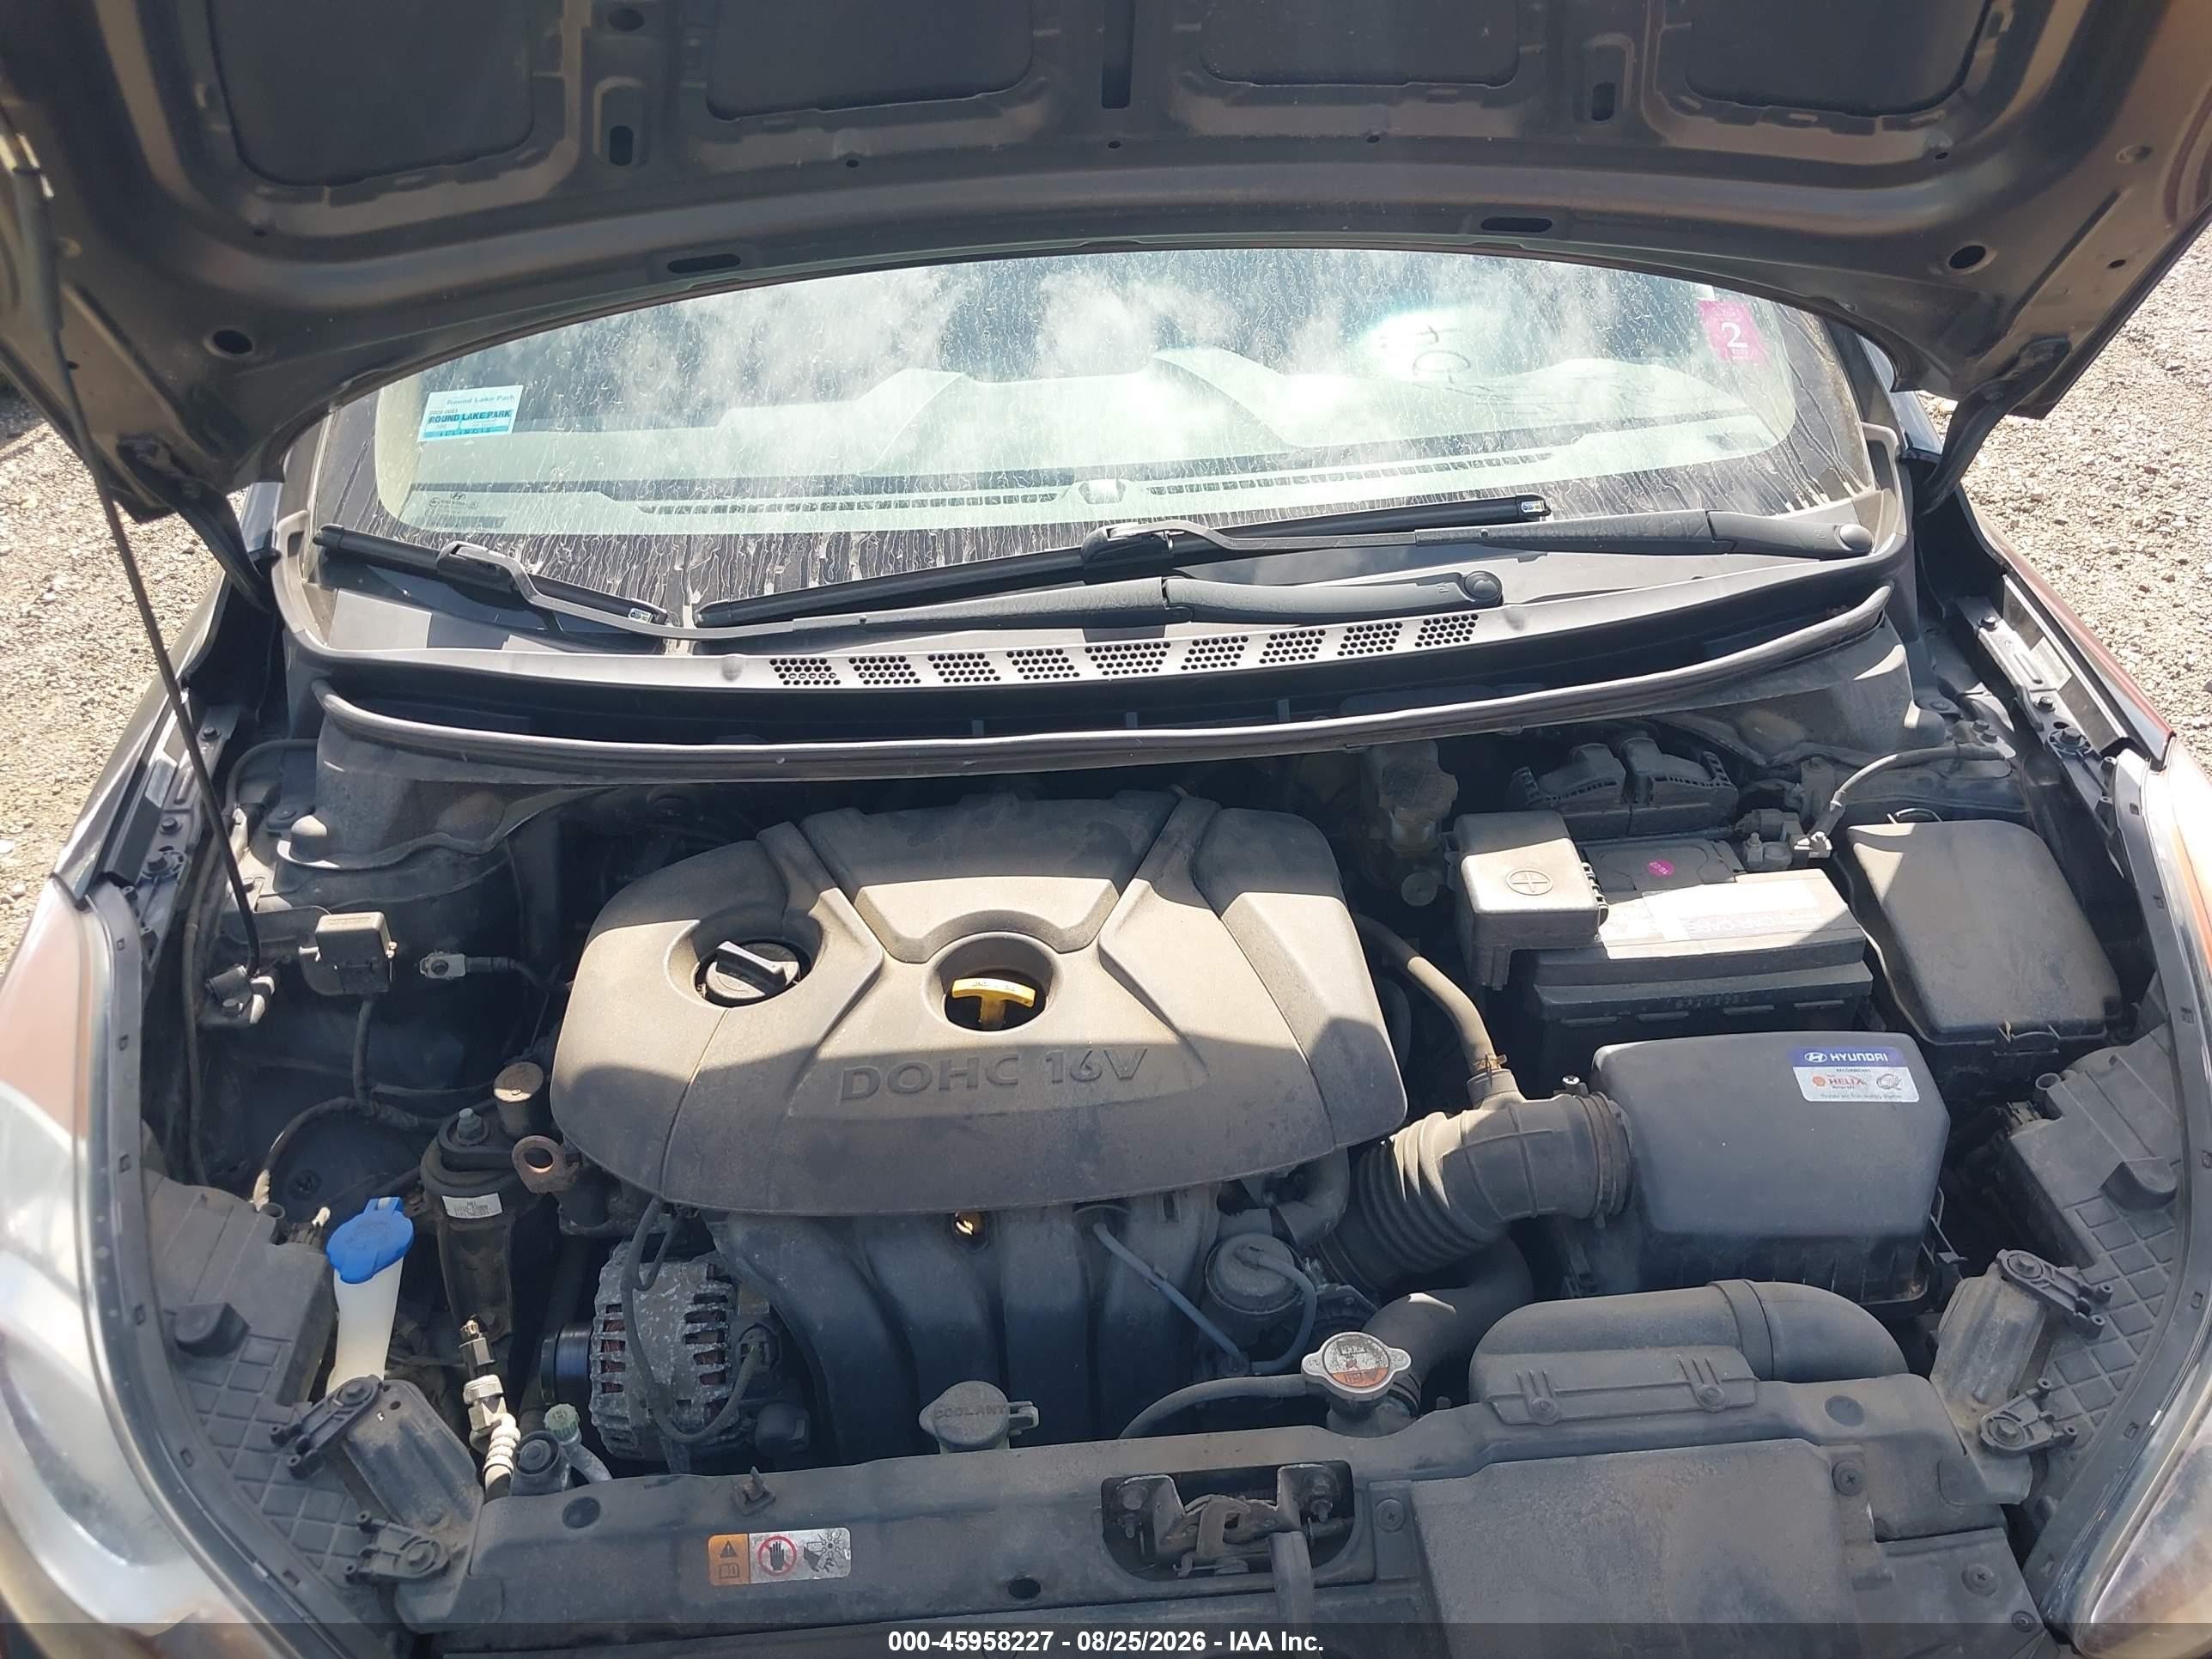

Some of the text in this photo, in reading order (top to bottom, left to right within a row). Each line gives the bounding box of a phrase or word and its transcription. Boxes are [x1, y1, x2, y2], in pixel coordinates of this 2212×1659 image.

[1721, 321, 1748, 348] 2
[429, 410, 511, 423] ROUND LAKE PARK
[440, 428, 491, 436] ILLINOIS
[1830, 1053, 1888, 1062] HYUNDAI
[838, 1047, 1148, 1105] DOHC 16V
[1828, 1077, 1865, 1085] HELIX
[933, 1405, 1006, 1419] COOLANT
